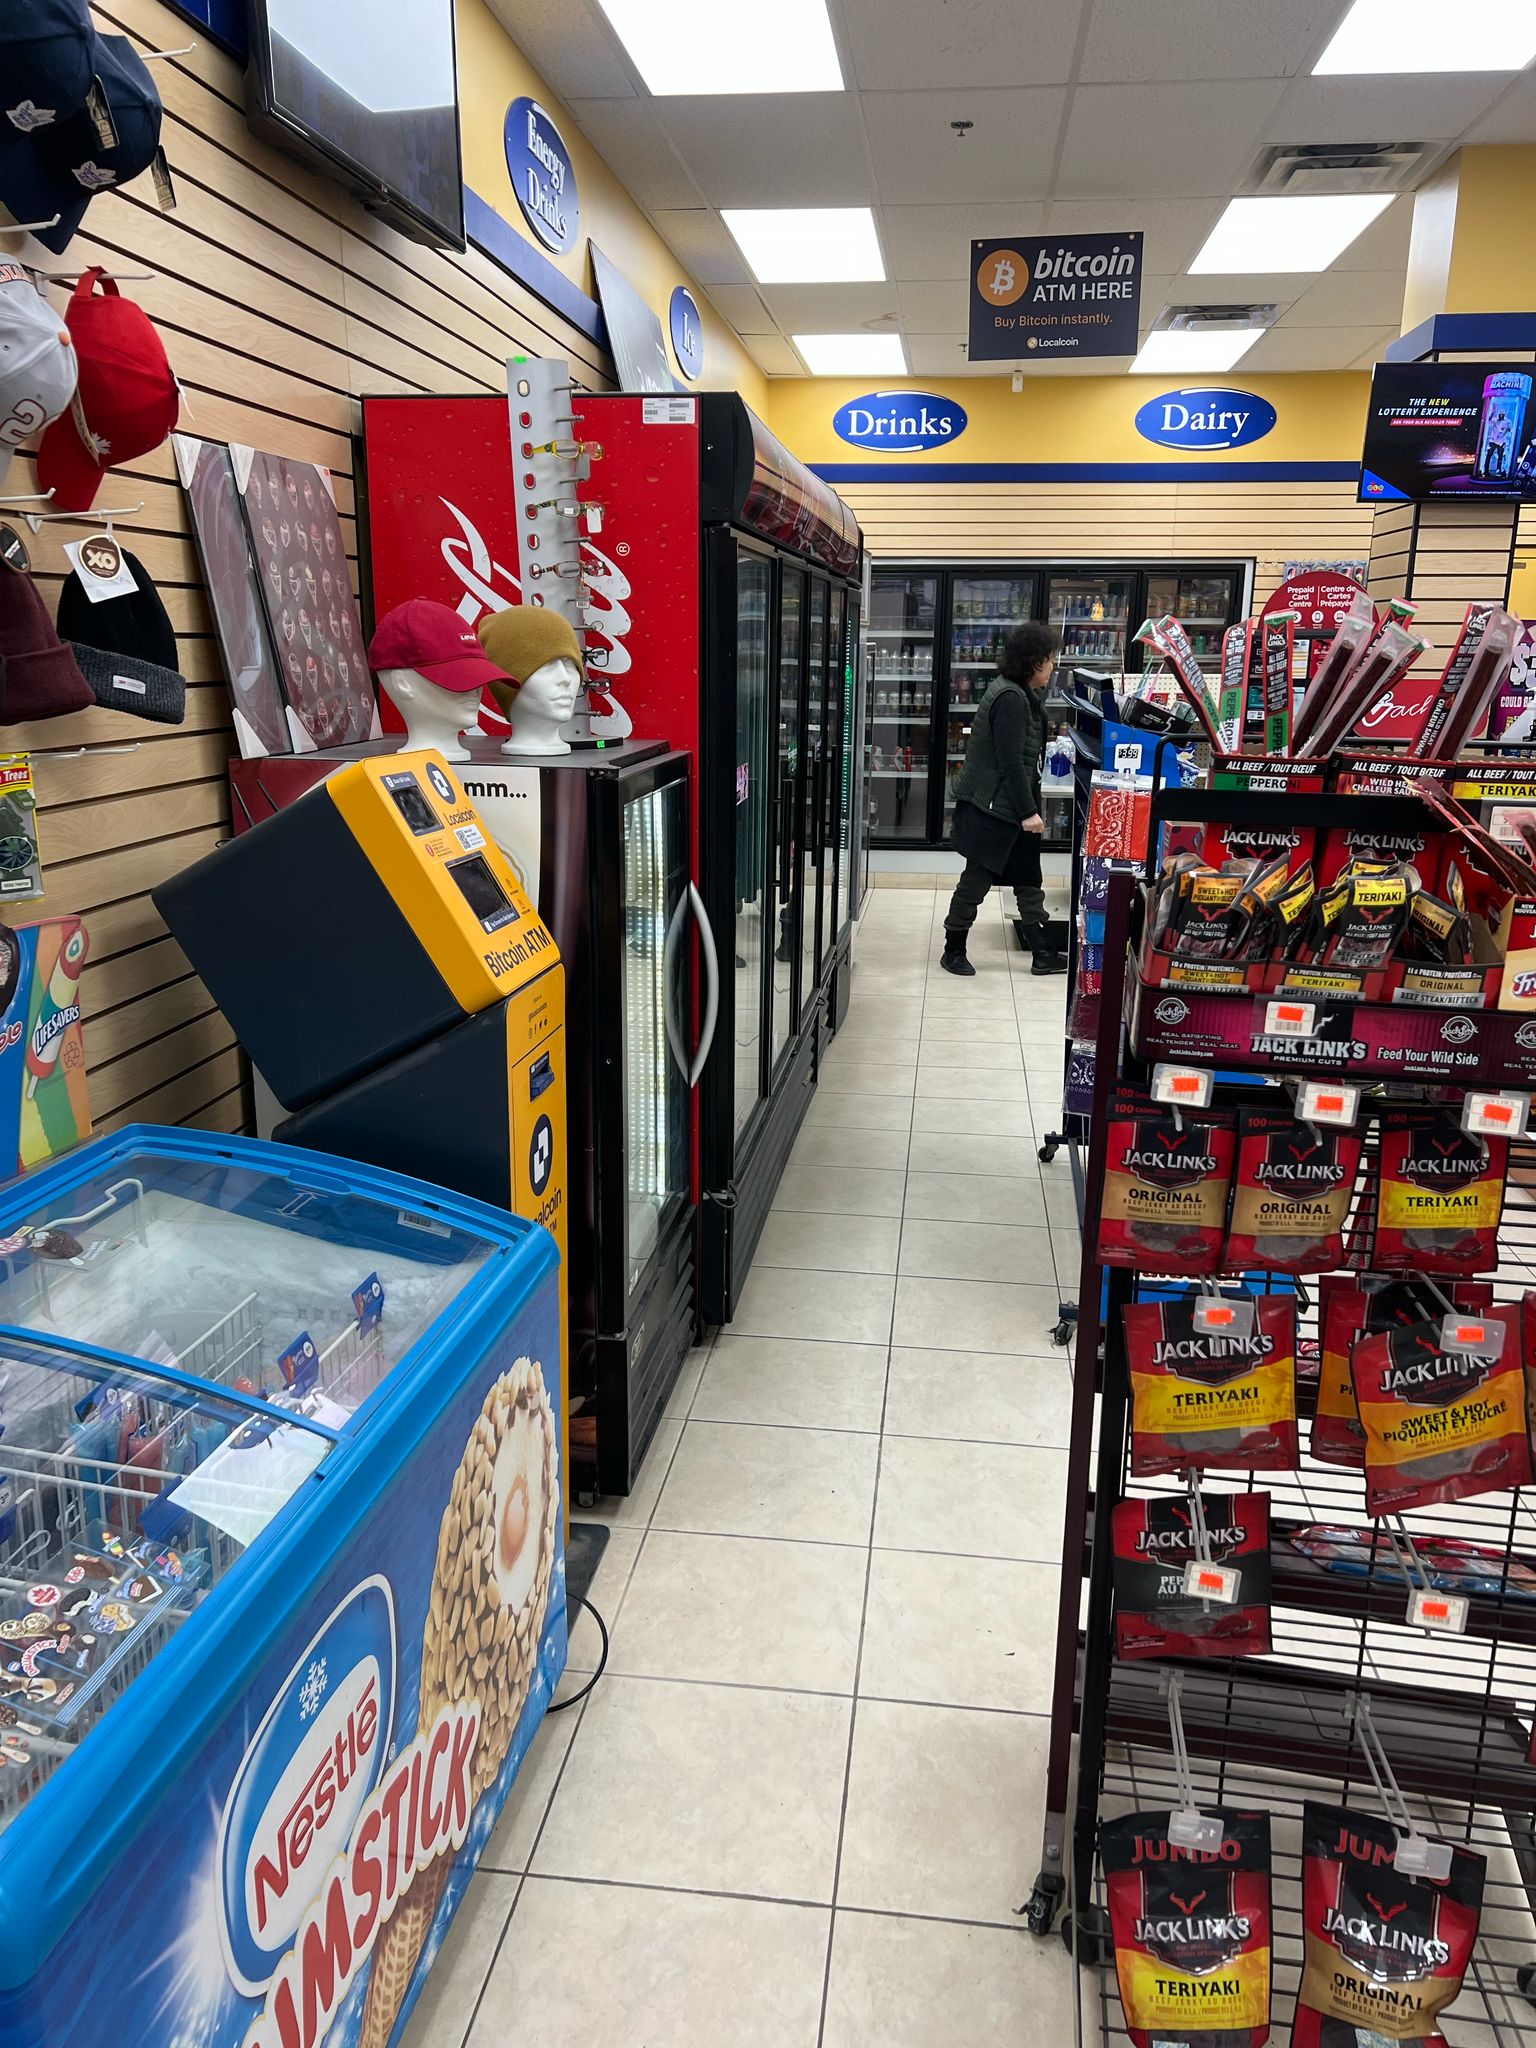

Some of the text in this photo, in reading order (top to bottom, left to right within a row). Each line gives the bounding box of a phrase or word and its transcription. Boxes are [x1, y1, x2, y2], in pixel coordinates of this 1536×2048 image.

[526, 109, 567, 196] Energy
[526, 167, 568, 240] Drinks
[1033, 246, 1135, 279] bitcoin
[1032, 281, 1133, 302] ATM HERE
[994, 312, 1113, 330] Buy Bitcoin instantly.
[681, 312, 696, 357] Ice
[1038, 336, 1079, 348] Localcoin
[1409, 398, 1450, 406] THE NEW
[1161, 403, 1250, 438] Dairy
[1378, 407, 1478, 416] LOTTERY EXPERIENCE
[847, 408, 952, 436] Drinks
[1287, 586, 1315, 594] Prepaid
[1321, 585, 1345, 593] Centre
[1288, 600, 1312, 608] Centre
[1500, 696, 1522, 708] COULD
[1226, 761, 1242, 770] ALL
[1243, 762, 1264, 771] BEEF
[1270, 763, 1291, 772] TOUT
[1352, 762, 1367, 772] ALL
[1369, 763, 1391, 773] BEEF
[1397, 765, 1419, 775] TOUT
[1467, 769, 1482, 779] ALL
[1483, 769, 1505, 779] BEEF
[1511, 770, 1534, 780] TOUT
[3, 770, 28, 782] Trees
[1370, 778, 1393, 787] WILD
[1352, 784, 1393, 794] CHALEUR
[443, 807, 476, 826] Localcoin
[1220, 829, 1301, 847] JACK LINK'S
[1344, 832, 1425, 852] JACK LINK'S
[1358, 891, 1401, 902] TERIYAKI
[1185, 920, 1204, 929] JACK
[1346, 923, 1368, 932] JACK
[483, 924, 551, 978] Bitcoin ATM
[1301, 977, 1345, 988] TERIYAKI
[1420, 980, 1465, 991] ORIGINAL
[1401, 992, 1418, 1000] BEEF
[1251, 1036, 1367, 1060] JACK LINK'S
[1377, 1047, 1479, 1066] Feed Your Wild Side
[1273, 1056, 1342, 1066] PREMIUM CUTS
[1116, 1087, 1133, 1098] 100
[1114, 1104, 1134, 1114] 100
[1248, 1117, 1266, 1128] 100
[1121, 1149, 1217, 1172] JACK LINK'S
[1397, 1155, 1490, 1175] JACK LINK'S
[1254, 1162, 1344, 1182] JACK LINK'S
[1128, 1188, 1203, 1204] ORIGINAL
[1406, 1195, 1479, 1208] TERIYAKI
[1260, 1202, 1331, 1215] ORIGINAL
[1153, 1334, 1274, 1364] JACK LINK'S
[1380, 1361, 1435, 1391] JACK
[1173, 1386, 1259, 1408] TERIYAKI
[1383, 1401, 1507, 1442] PIQUANT ET SUCRÉ
[1401, 1398, 1489, 1430] SWEET & HOT
[1136, 1530, 1187, 1551] JACK
[1157, 1584, 1177, 1595] AU
[253, 1675, 379, 1934] Nestlé
[1135, 1916, 1250, 1943] JACK LINK'S
[1322, 1908, 1449, 1965] JACK LINK'S
[1155, 1979, 1241, 1997] TERIYAKI
[1333, 1972, 1423, 2011] ORIGINAL
